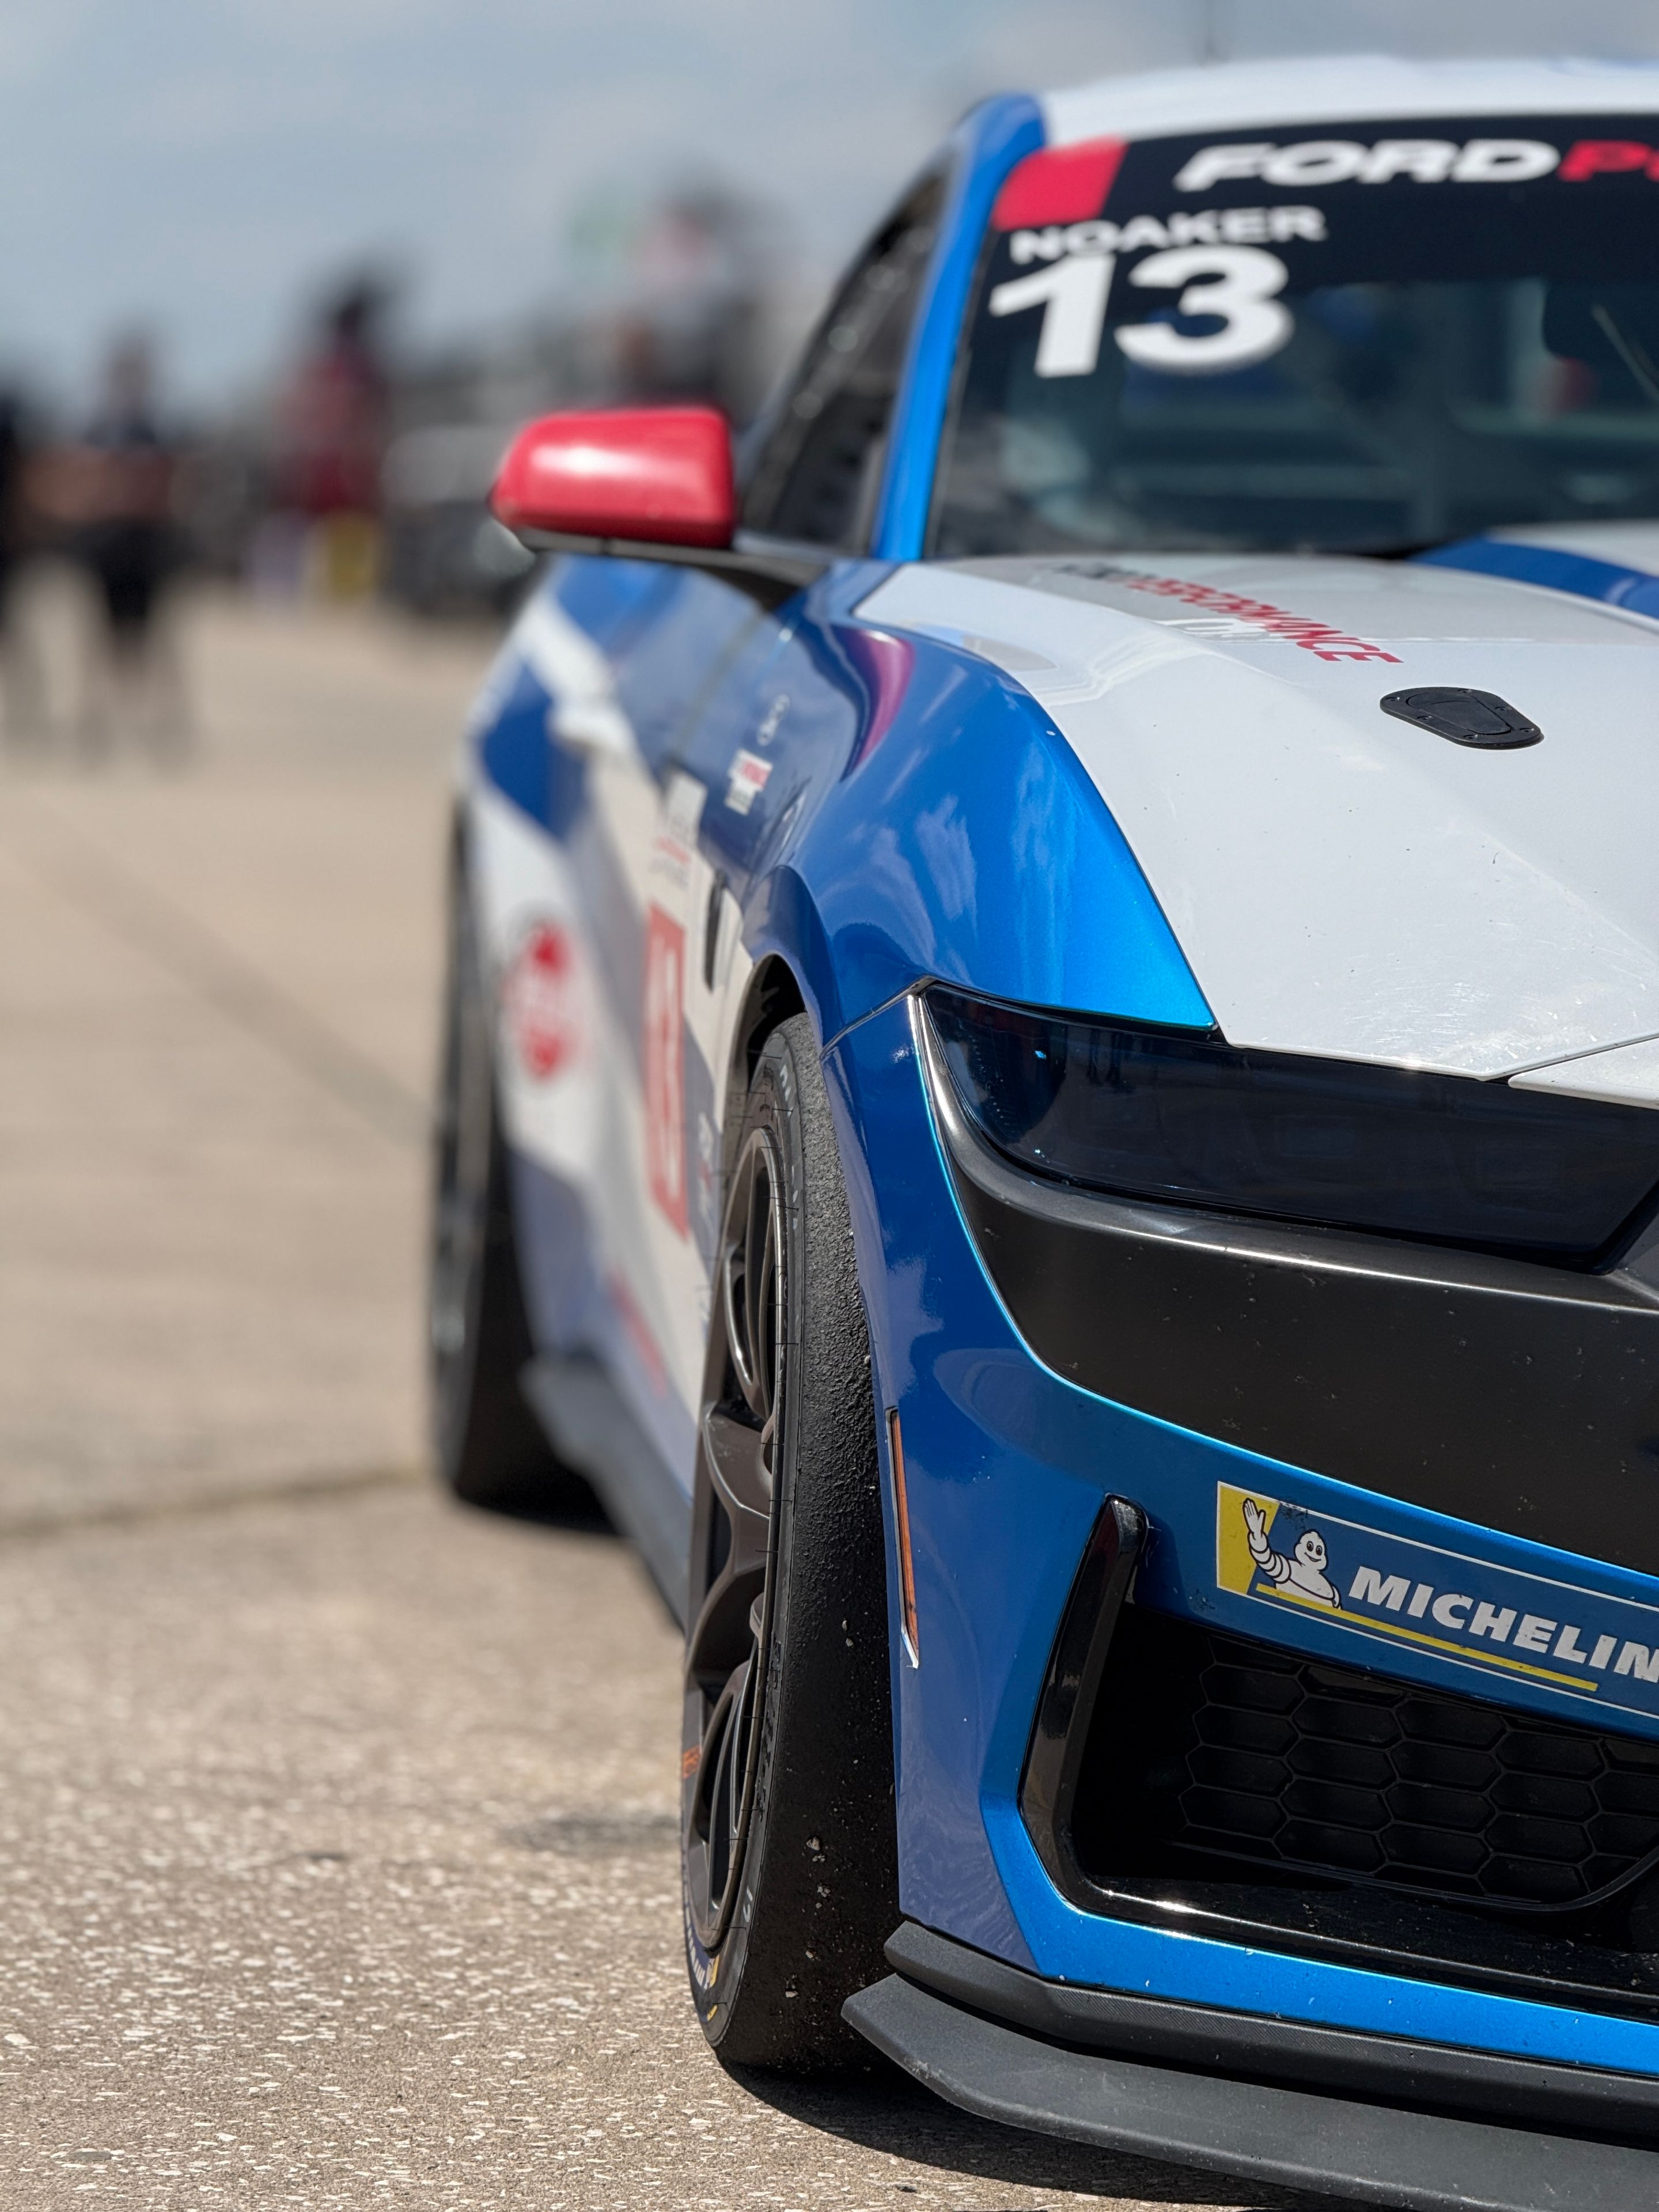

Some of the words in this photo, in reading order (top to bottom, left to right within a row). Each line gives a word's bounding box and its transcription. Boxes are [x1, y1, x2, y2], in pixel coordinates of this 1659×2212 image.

[1173, 139, 1561, 192] FORD
[1556, 140, 1659, 183] P
[1009, 205, 1327, 264] NOAKER
[988, 243, 1294, 378] 13
[1348, 1566, 1659, 1683] MICHELIN
